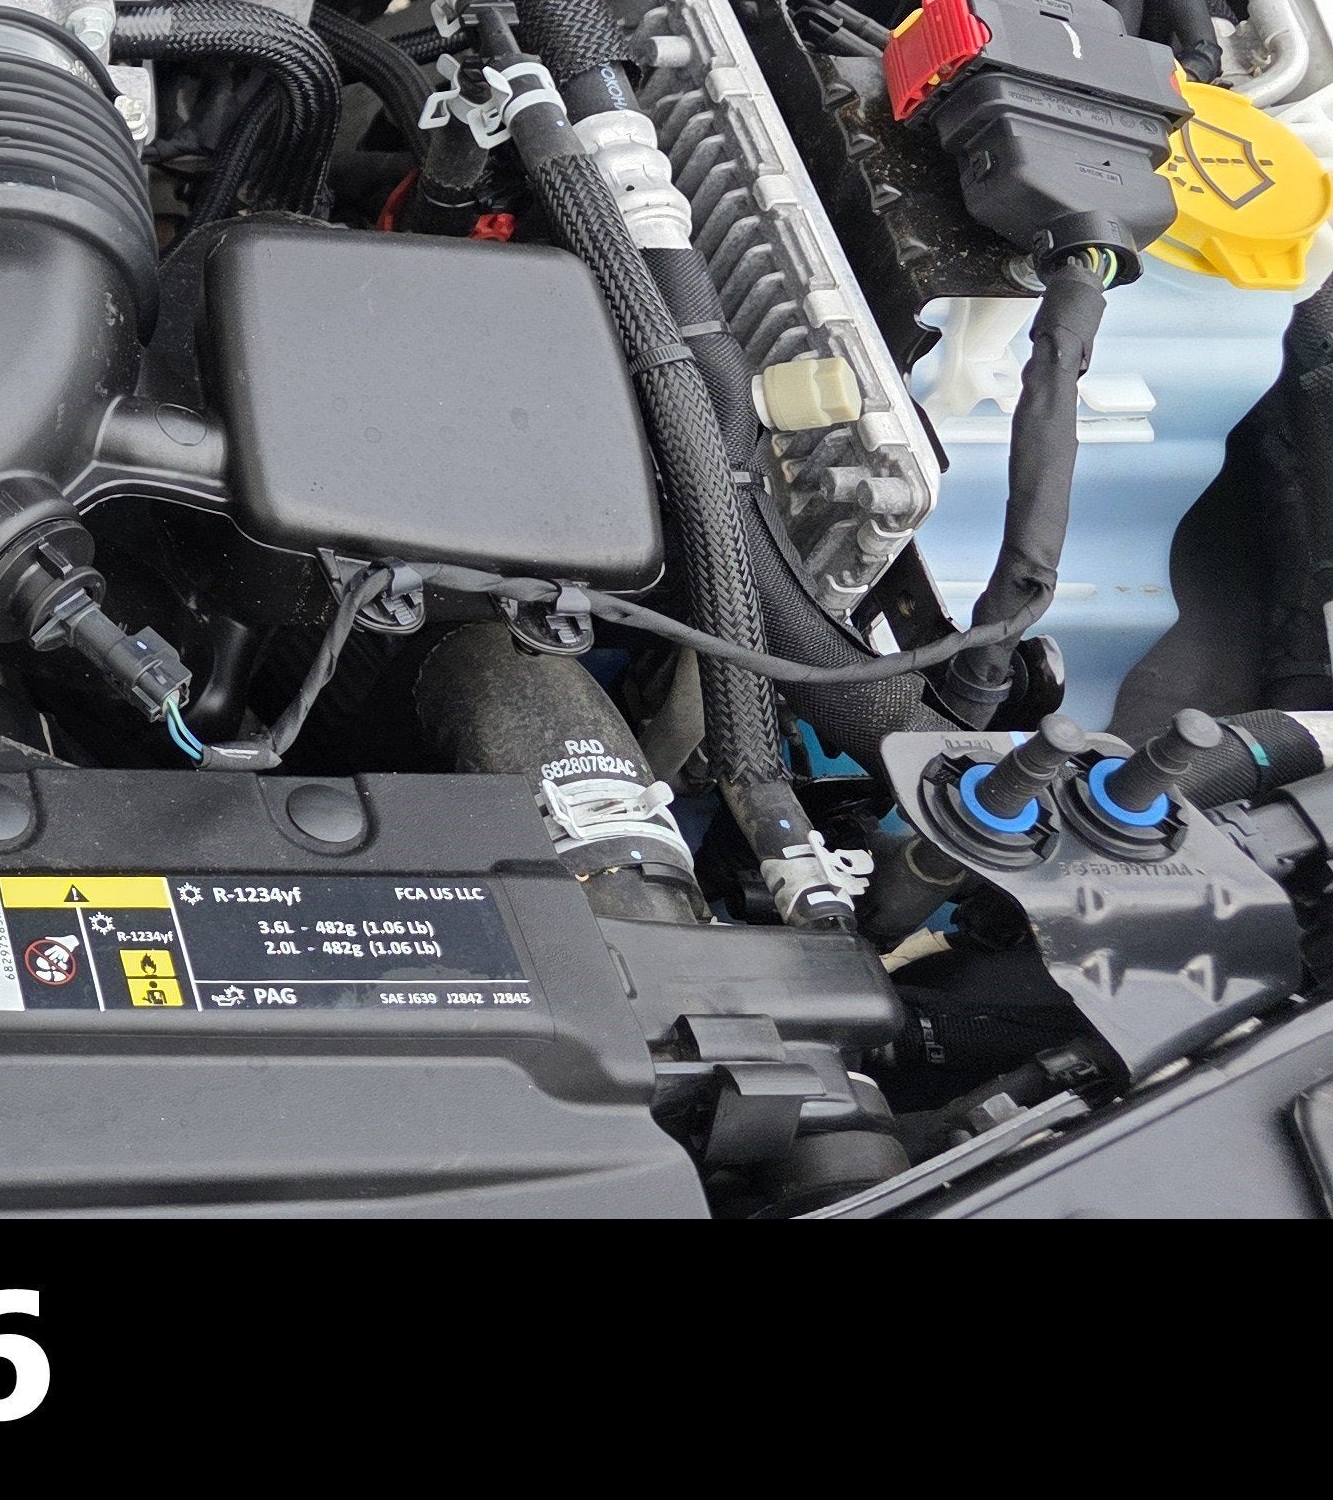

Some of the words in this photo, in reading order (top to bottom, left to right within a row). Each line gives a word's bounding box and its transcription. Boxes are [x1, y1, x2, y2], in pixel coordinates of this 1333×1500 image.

[564, 739, 604, 755] RAD
[541, 755, 637, 780] 68280782AC
[212, 886, 302, 907] R-1234yf
[394, 887, 429, 900] FCA
[429, 887, 454, 900] US
[455, 887, 486, 900] LLC
[117, 930, 174, 945] R-1234yf
[257, 920, 296, 934] 3.6L
[315, 920, 358, 937] 482g
[362, 920, 406, 937] (1.06
[406, 920, 435, 938] Lb)
[263, 940, 302, 955] 2.0L
[322, 941, 365, 958] 482g
[369, 940, 413, 958] (1.06
[413, 940, 442, 958] Lb)
[253, 987, 298, 1005] PAG
[379, 992, 407, 1004] SAE
[492, 992, 531, 1004] J2845
